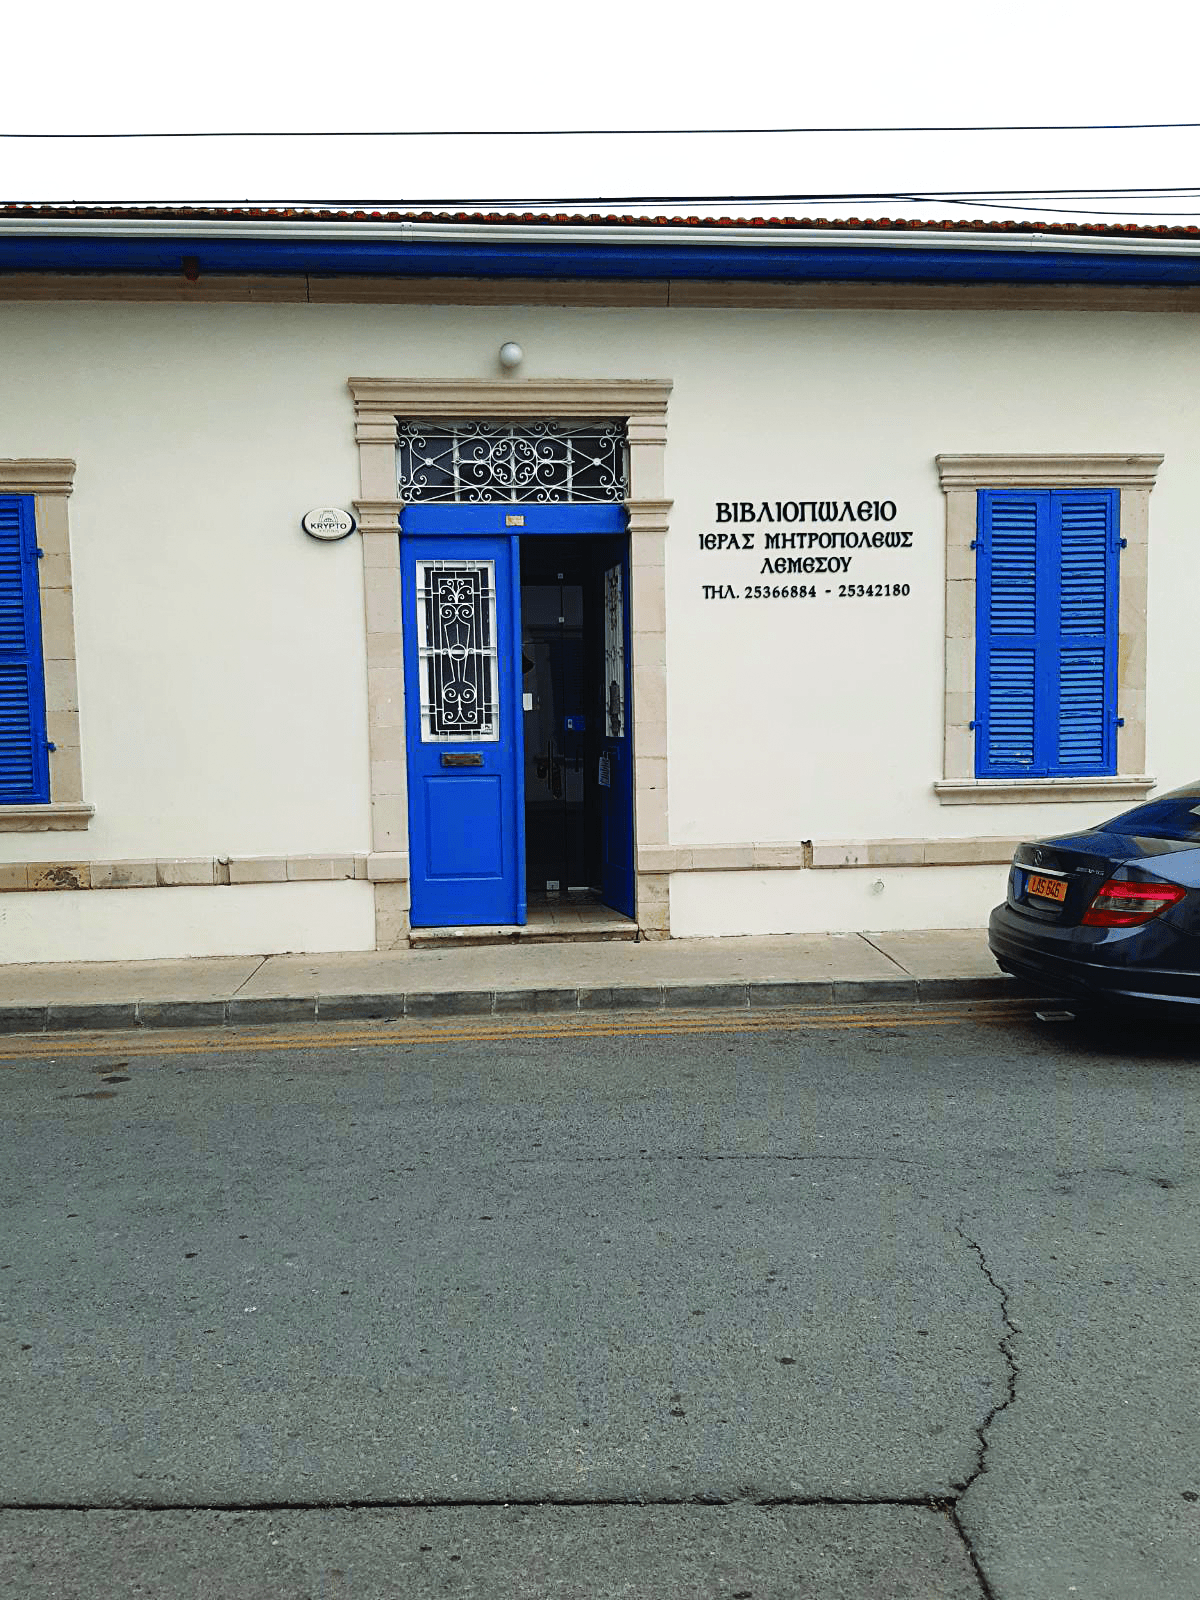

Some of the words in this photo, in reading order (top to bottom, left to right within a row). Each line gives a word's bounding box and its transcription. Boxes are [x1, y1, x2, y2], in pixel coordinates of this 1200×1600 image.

[715, 500, 897, 523] ΒΙΒΛΙΟΠΩΛΕΙΟ
[310, 522, 347, 530] KRYPTO
[698, 533, 755, 550] ΙΕΡΑΣ
[764, 531, 914, 549] ΜΗΤΡΟΠΟΛΕΩΣ
[760, 556, 852, 574] ΛΕΜΕΣΟΥ
[702, 584, 740, 600] ΤΗΛ.
[744, 584, 817, 599] 25366884
[838, 583, 911, 598] 25342180
[1031, 878, 1047, 894] LAS
